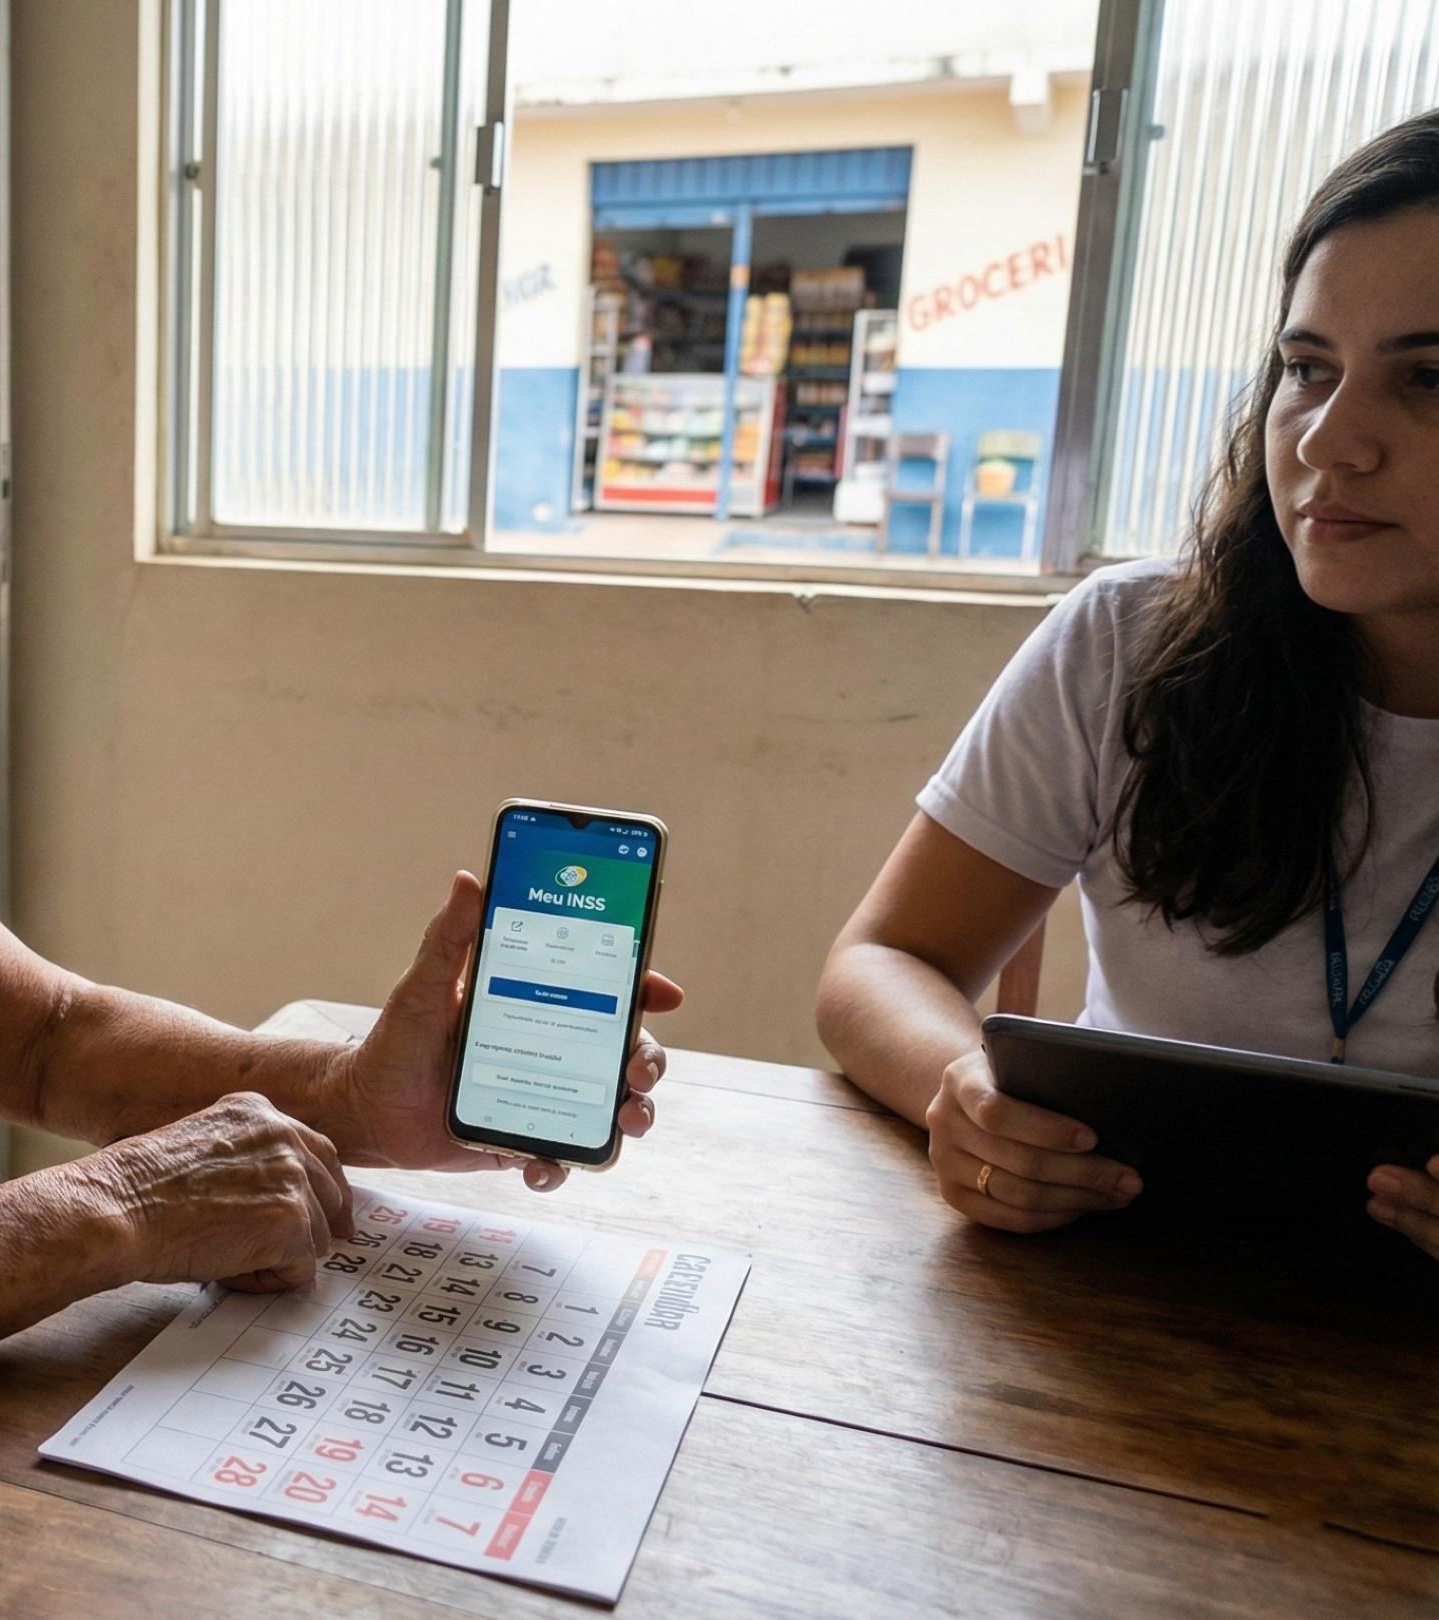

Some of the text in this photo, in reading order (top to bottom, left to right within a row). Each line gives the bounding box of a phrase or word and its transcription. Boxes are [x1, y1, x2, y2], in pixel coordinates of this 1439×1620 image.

[908, 233, 1067, 331] GROCERI
[528, 887, 606, 911] Meu INSS
[346, 1230, 387, 1248] 26
[322, 1251, 366, 1273] 28
[458, 1251, 498, 1269] 13
[439, 1276, 480, 1296] 14
[417, 1304, 461, 1326] 15
[213, 1217, 461, 1487] 19 18 21 23 24 25 26 27 28
[395, 1333, 439, 1355] 16
[371, 1366, 417, 1390] 17
[354, 1264, 556, 1522] 7 8 9 10 11 12 13 14
[344, 1399, 391, 1424] 18
[435, 1304, 599, 1536] 1 2 3 4 5 6 7
[314, 1437, 364, 1461] 19
[283, 1471, 336, 1503] 20
